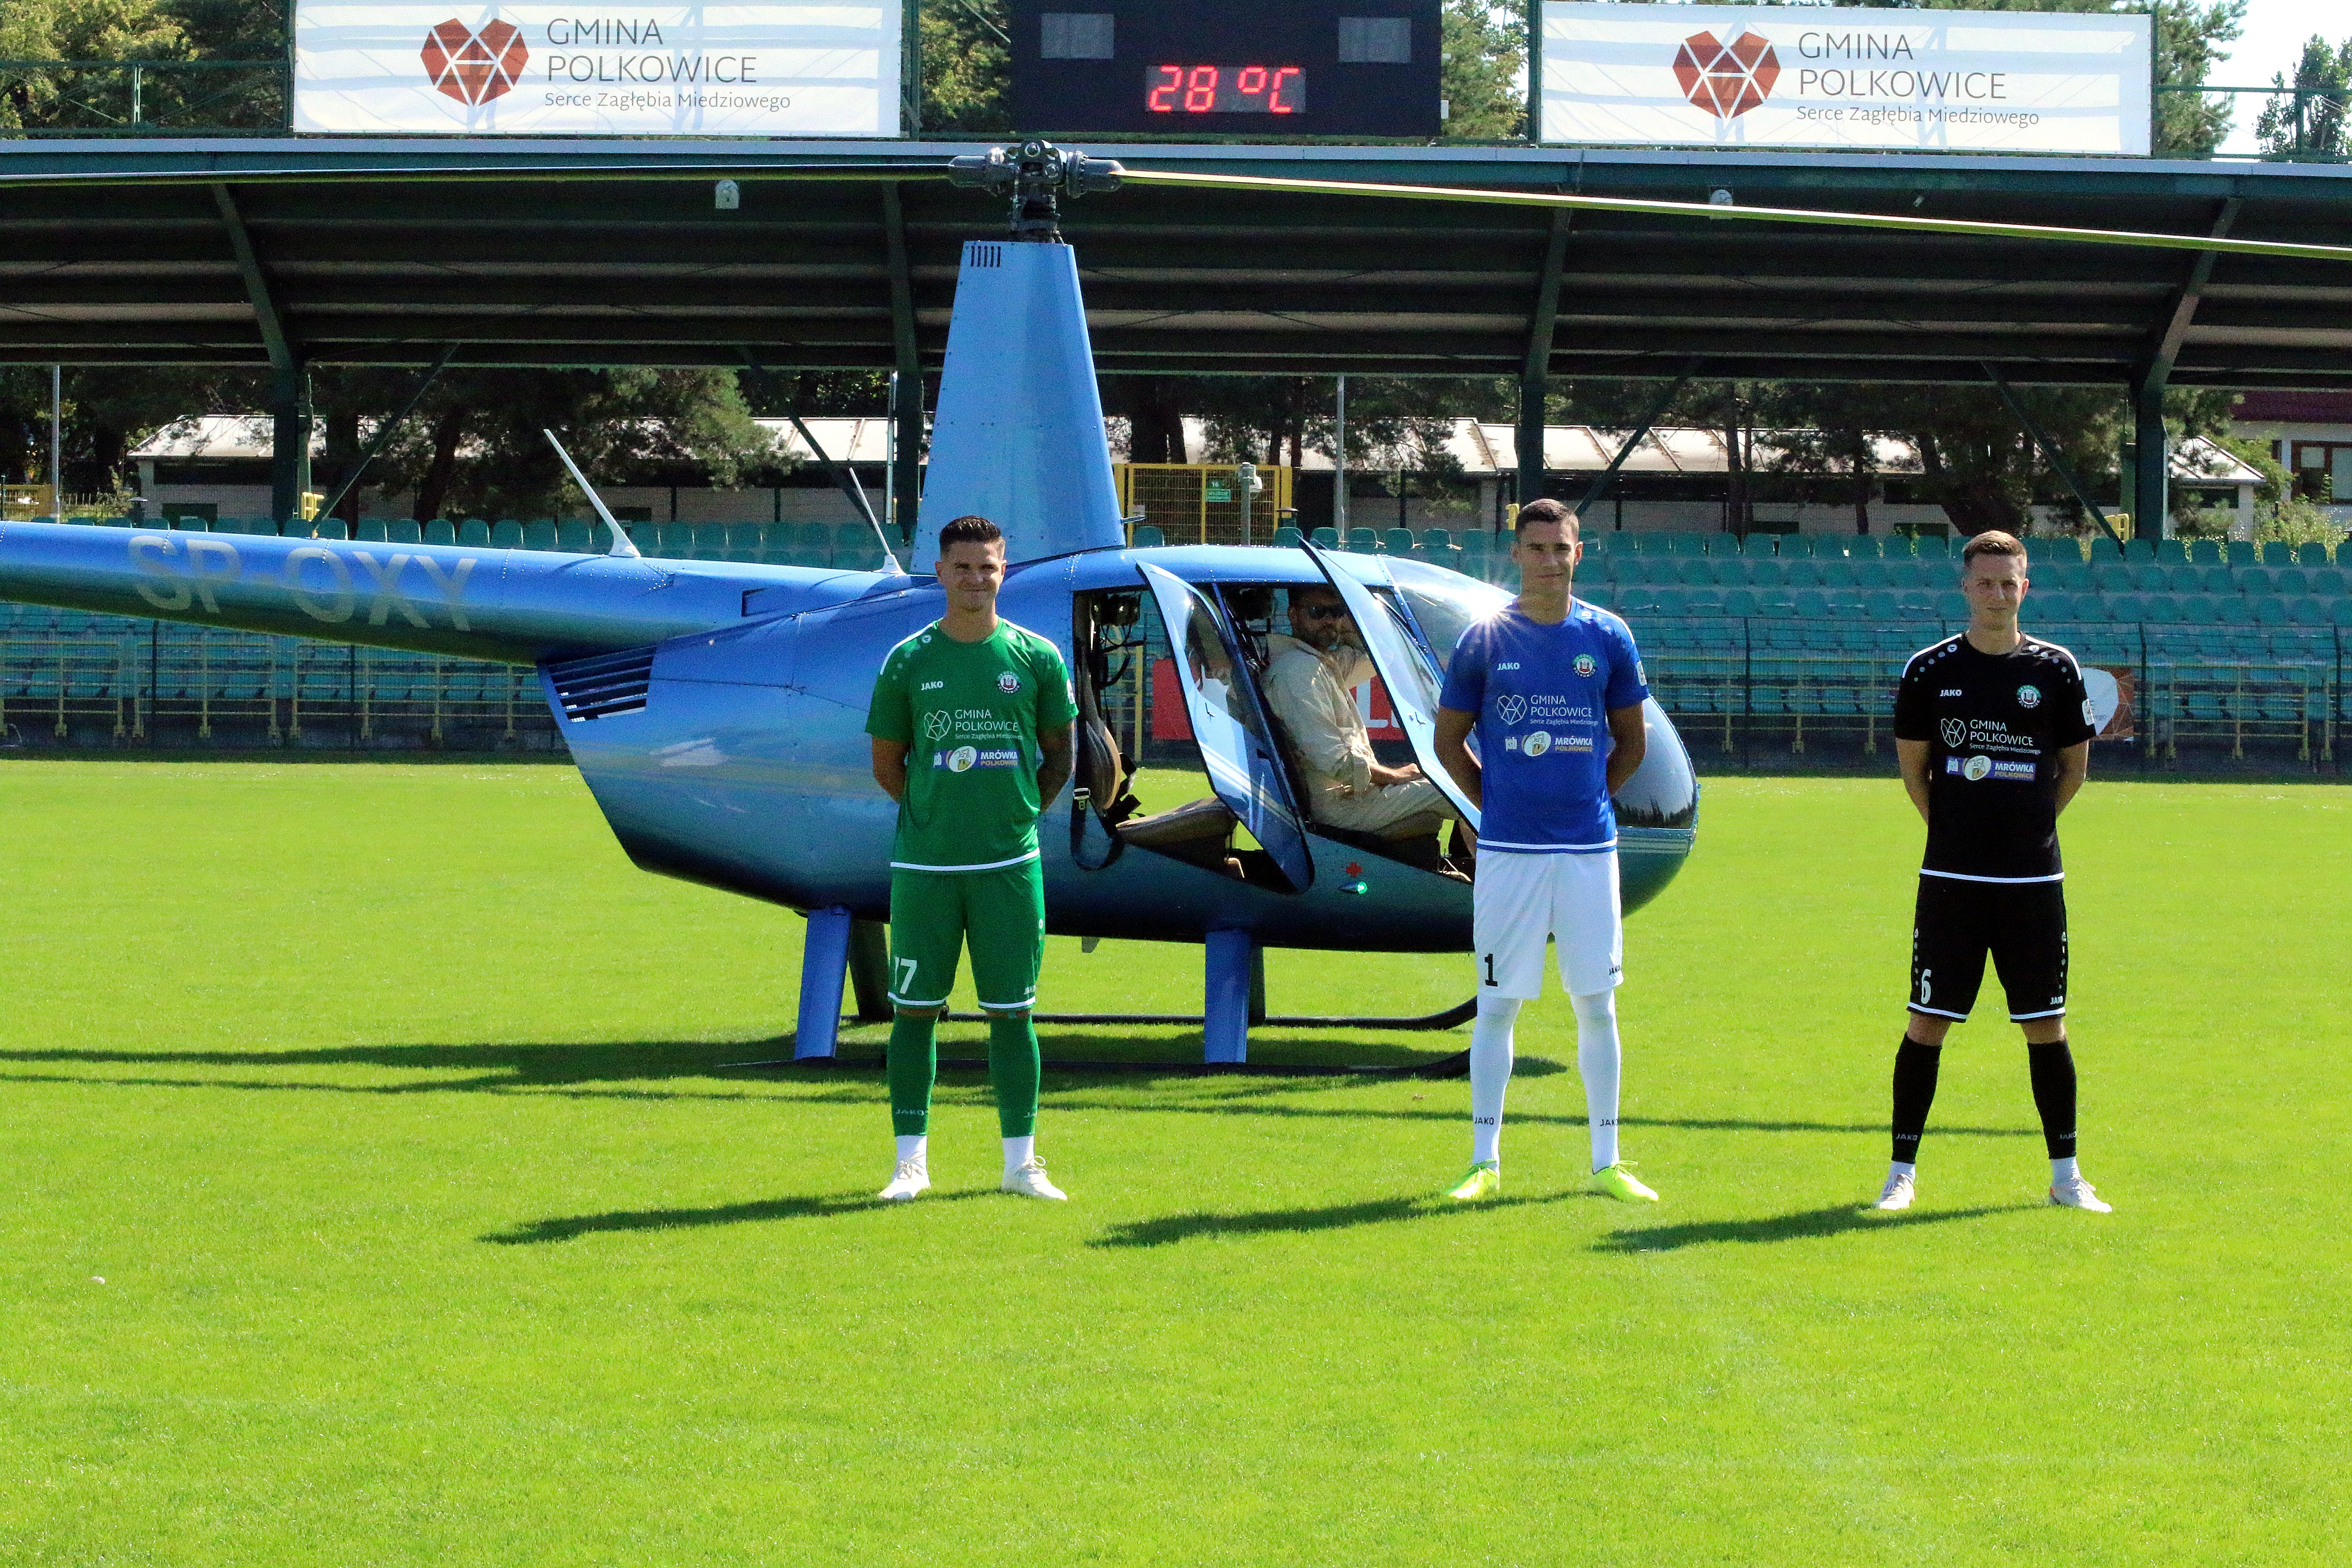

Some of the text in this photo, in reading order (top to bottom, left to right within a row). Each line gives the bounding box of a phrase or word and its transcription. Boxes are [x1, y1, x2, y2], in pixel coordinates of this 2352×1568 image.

[547, 18, 664, 45] GMINA
[1798, 32, 1914, 60] GMINA
[548, 55, 757, 83] POLKOWICE
[1148, 65, 1219, 112] 28
[1800, 69, 2006, 99] POLKOWICE
[545, 91, 790, 112] Serce Zagłębia Miedziowego
[1797, 105, 2039, 129] Serce Zagłębia Miedziowego
[1497, 662, 1520, 671] JAKO
[921, 680, 944, 691] JAKO
[1531, 695, 1566, 705] GMINA
[955, 709, 992, 719] GMINA
[1531, 706, 1592, 717] POLKOWICE
[955, 720, 1018, 732] POLKOWICE
[1970, 719, 2007, 732] GMINA
[1555, 735, 1593, 746] MRÓWKA
[1970, 731, 2034, 746] POLKOWICE
[980, 749, 1018, 760] MRÓWKA
[1995, 762, 2034, 773] MRÓWKA
[1484, 953, 1498, 987] 1
[1920, 968, 1932, 1004] 6
[1474, 1117, 1494, 1126] JAKO
[1600, 1118, 1619, 1127] JAKO
[1896, 1133, 1918, 1141] JAKO
